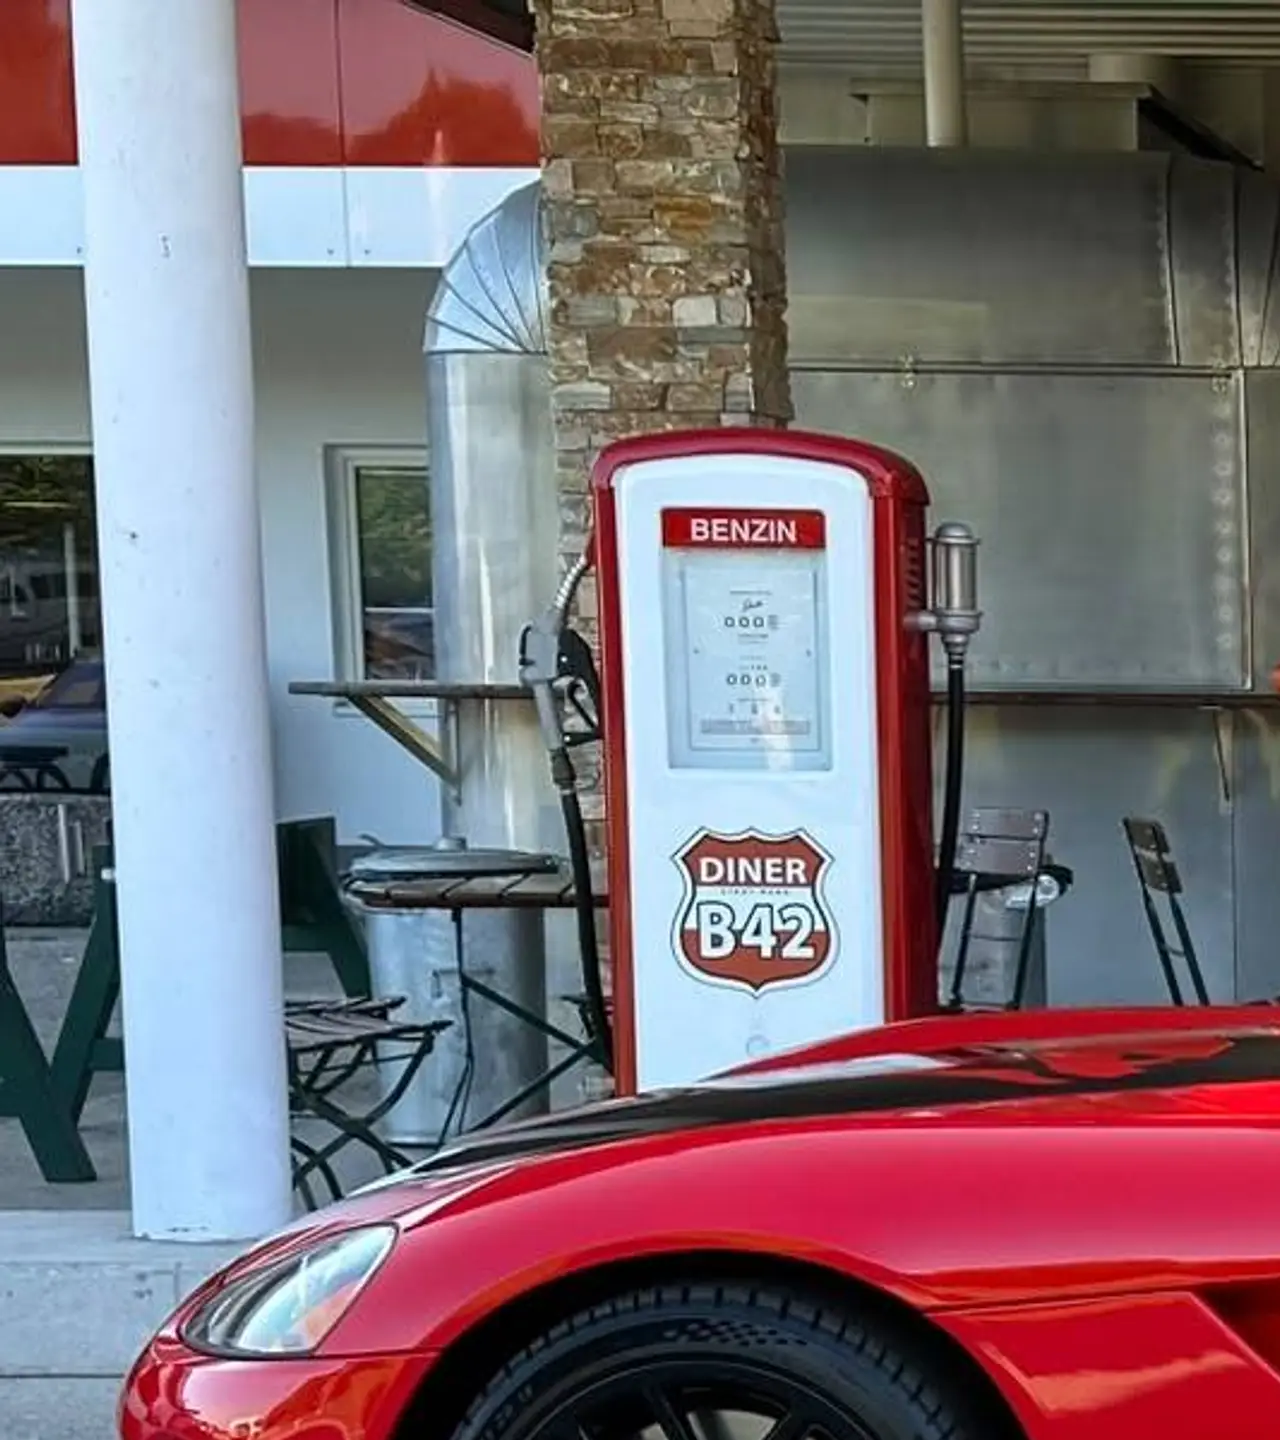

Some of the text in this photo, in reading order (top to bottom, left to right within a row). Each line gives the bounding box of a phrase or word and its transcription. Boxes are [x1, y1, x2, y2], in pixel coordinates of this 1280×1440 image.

[690, 518, 798, 543] BENZIN
[699, 856, 808, 884] DINER
[696, 900, 817, 960] B42
